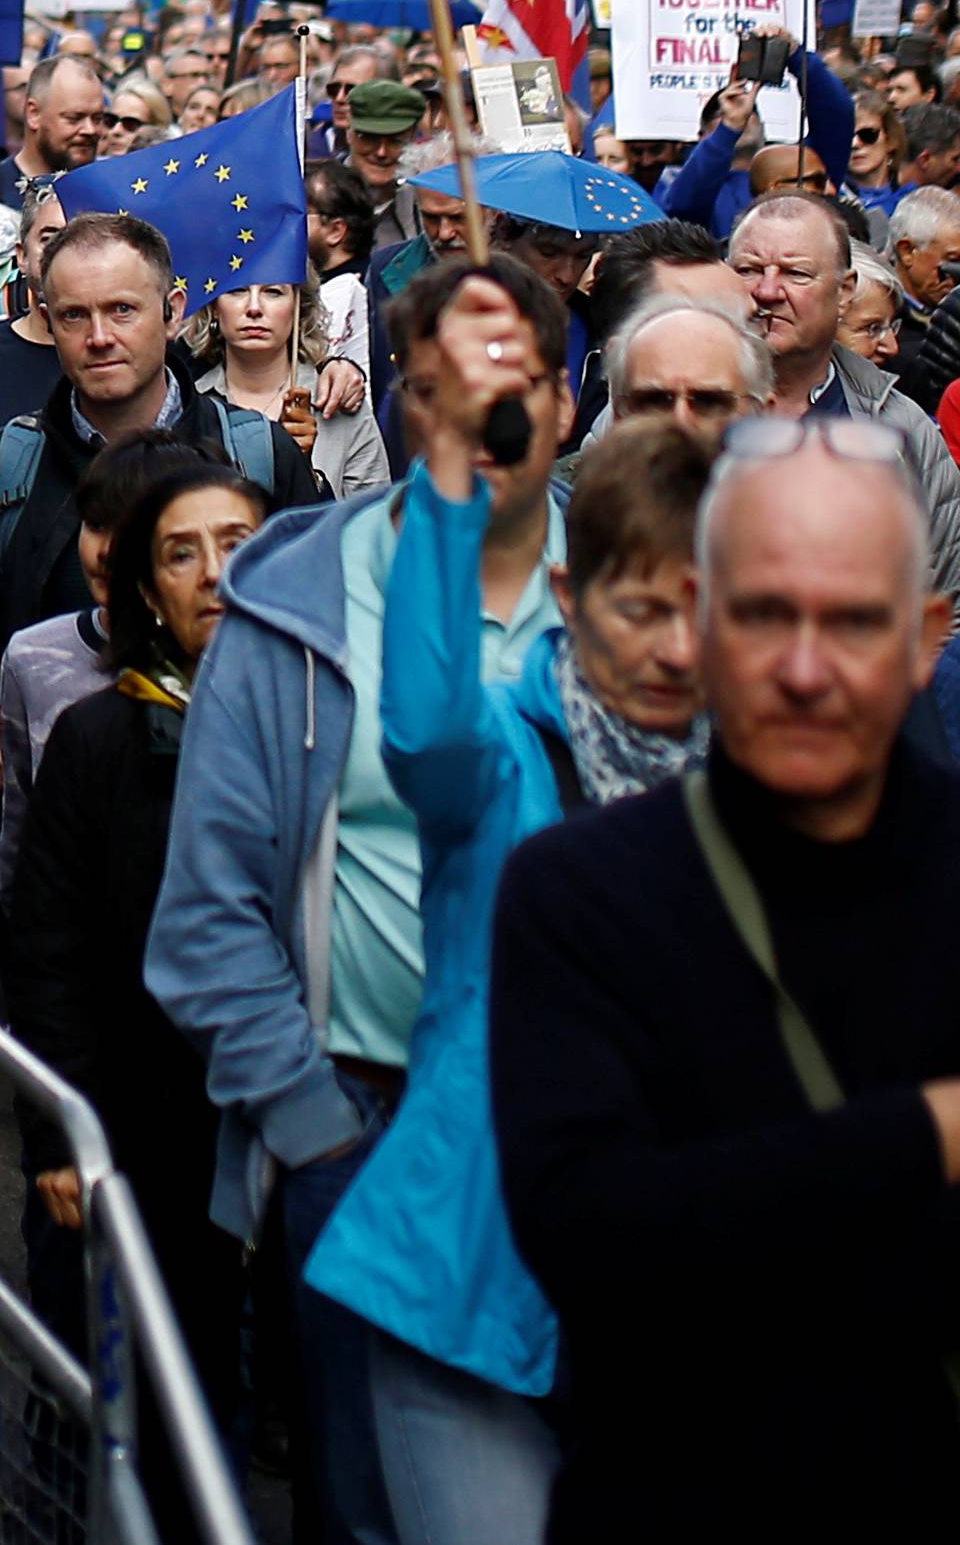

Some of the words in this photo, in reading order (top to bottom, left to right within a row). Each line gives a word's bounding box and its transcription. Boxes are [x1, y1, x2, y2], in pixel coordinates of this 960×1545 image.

[685, 13, 717, 33] for
[722, 12, 756, 32] the
[656, 38, 729, 64] FINAL
